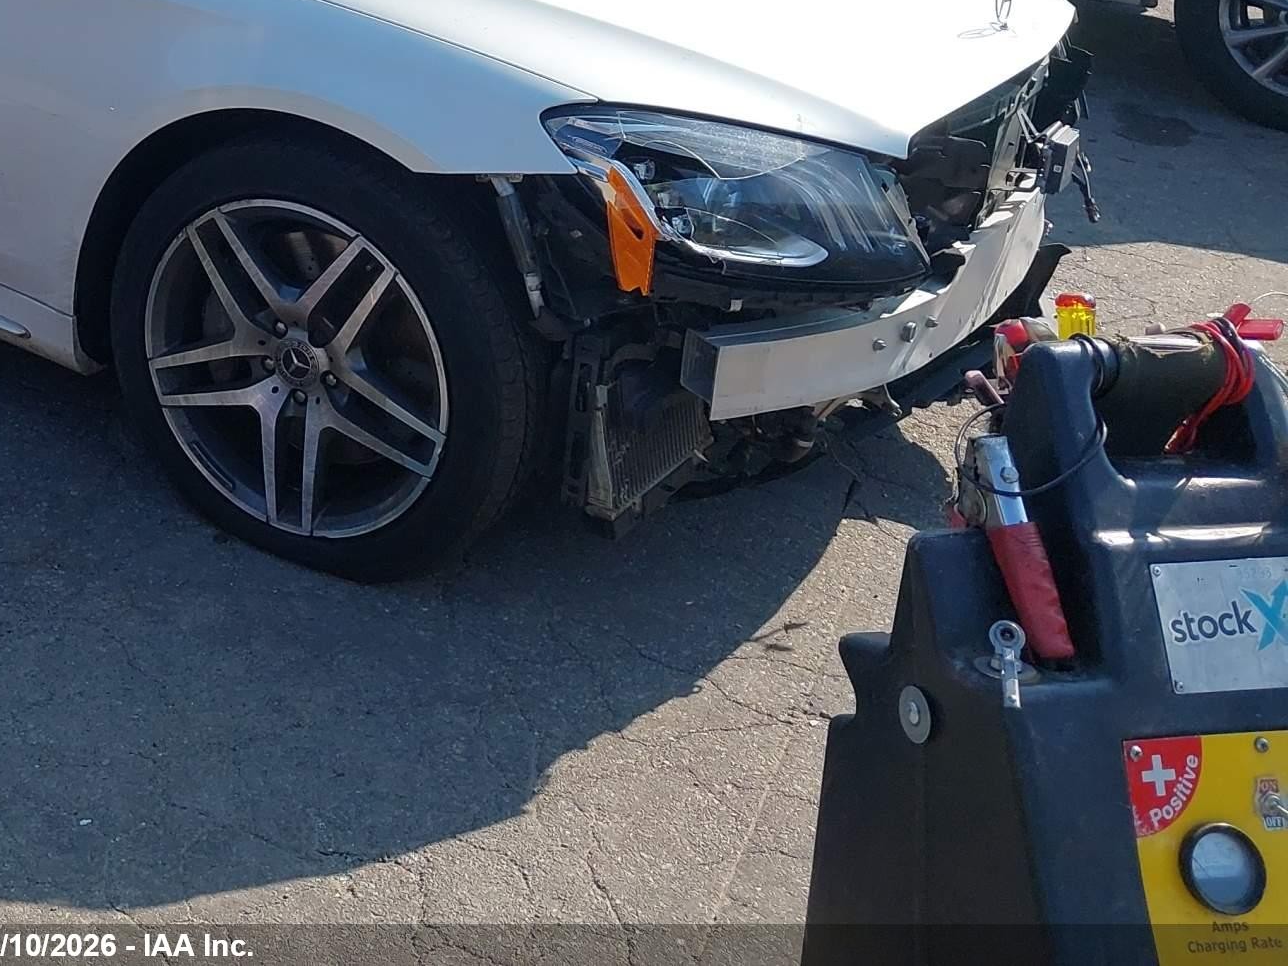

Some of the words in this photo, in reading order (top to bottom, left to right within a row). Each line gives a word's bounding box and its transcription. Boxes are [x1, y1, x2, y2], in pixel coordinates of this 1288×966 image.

[1149, 754, 1199, 828] Positive
[1261, 780, 1279, 792] ON
[1266, 816, 1282, 827] OFF
[1212, 921, 1249, 934] Amps
[1188, 939, 1247, 954] Charging
[1251, 937, 1283, 950] Rate
